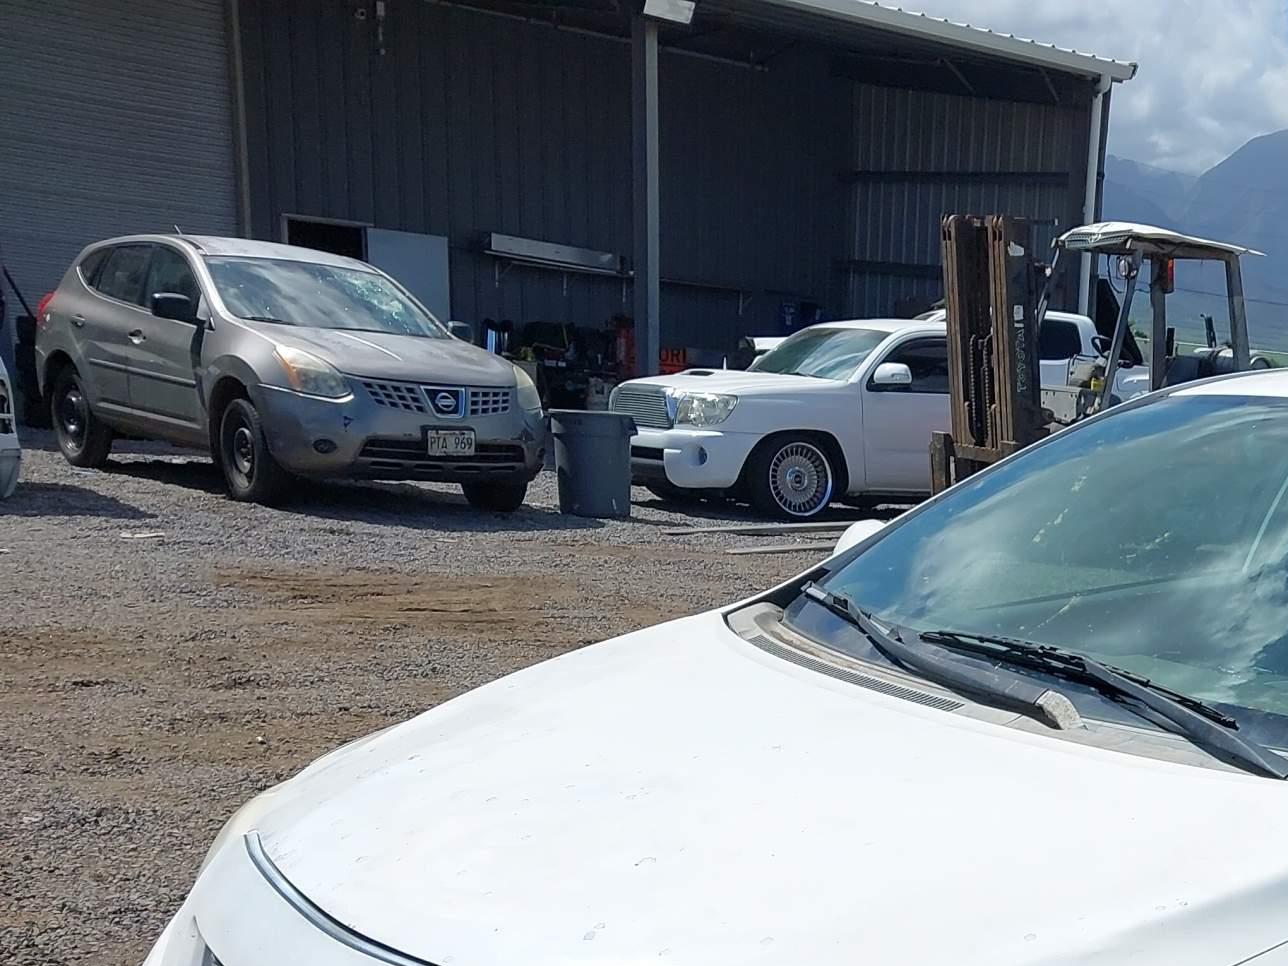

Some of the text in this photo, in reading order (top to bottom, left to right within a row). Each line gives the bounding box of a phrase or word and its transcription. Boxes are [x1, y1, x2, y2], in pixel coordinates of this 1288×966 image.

[1015, 328, 1027, 393] TOYOTA
[430, 436, 473, 449] PTA 969
